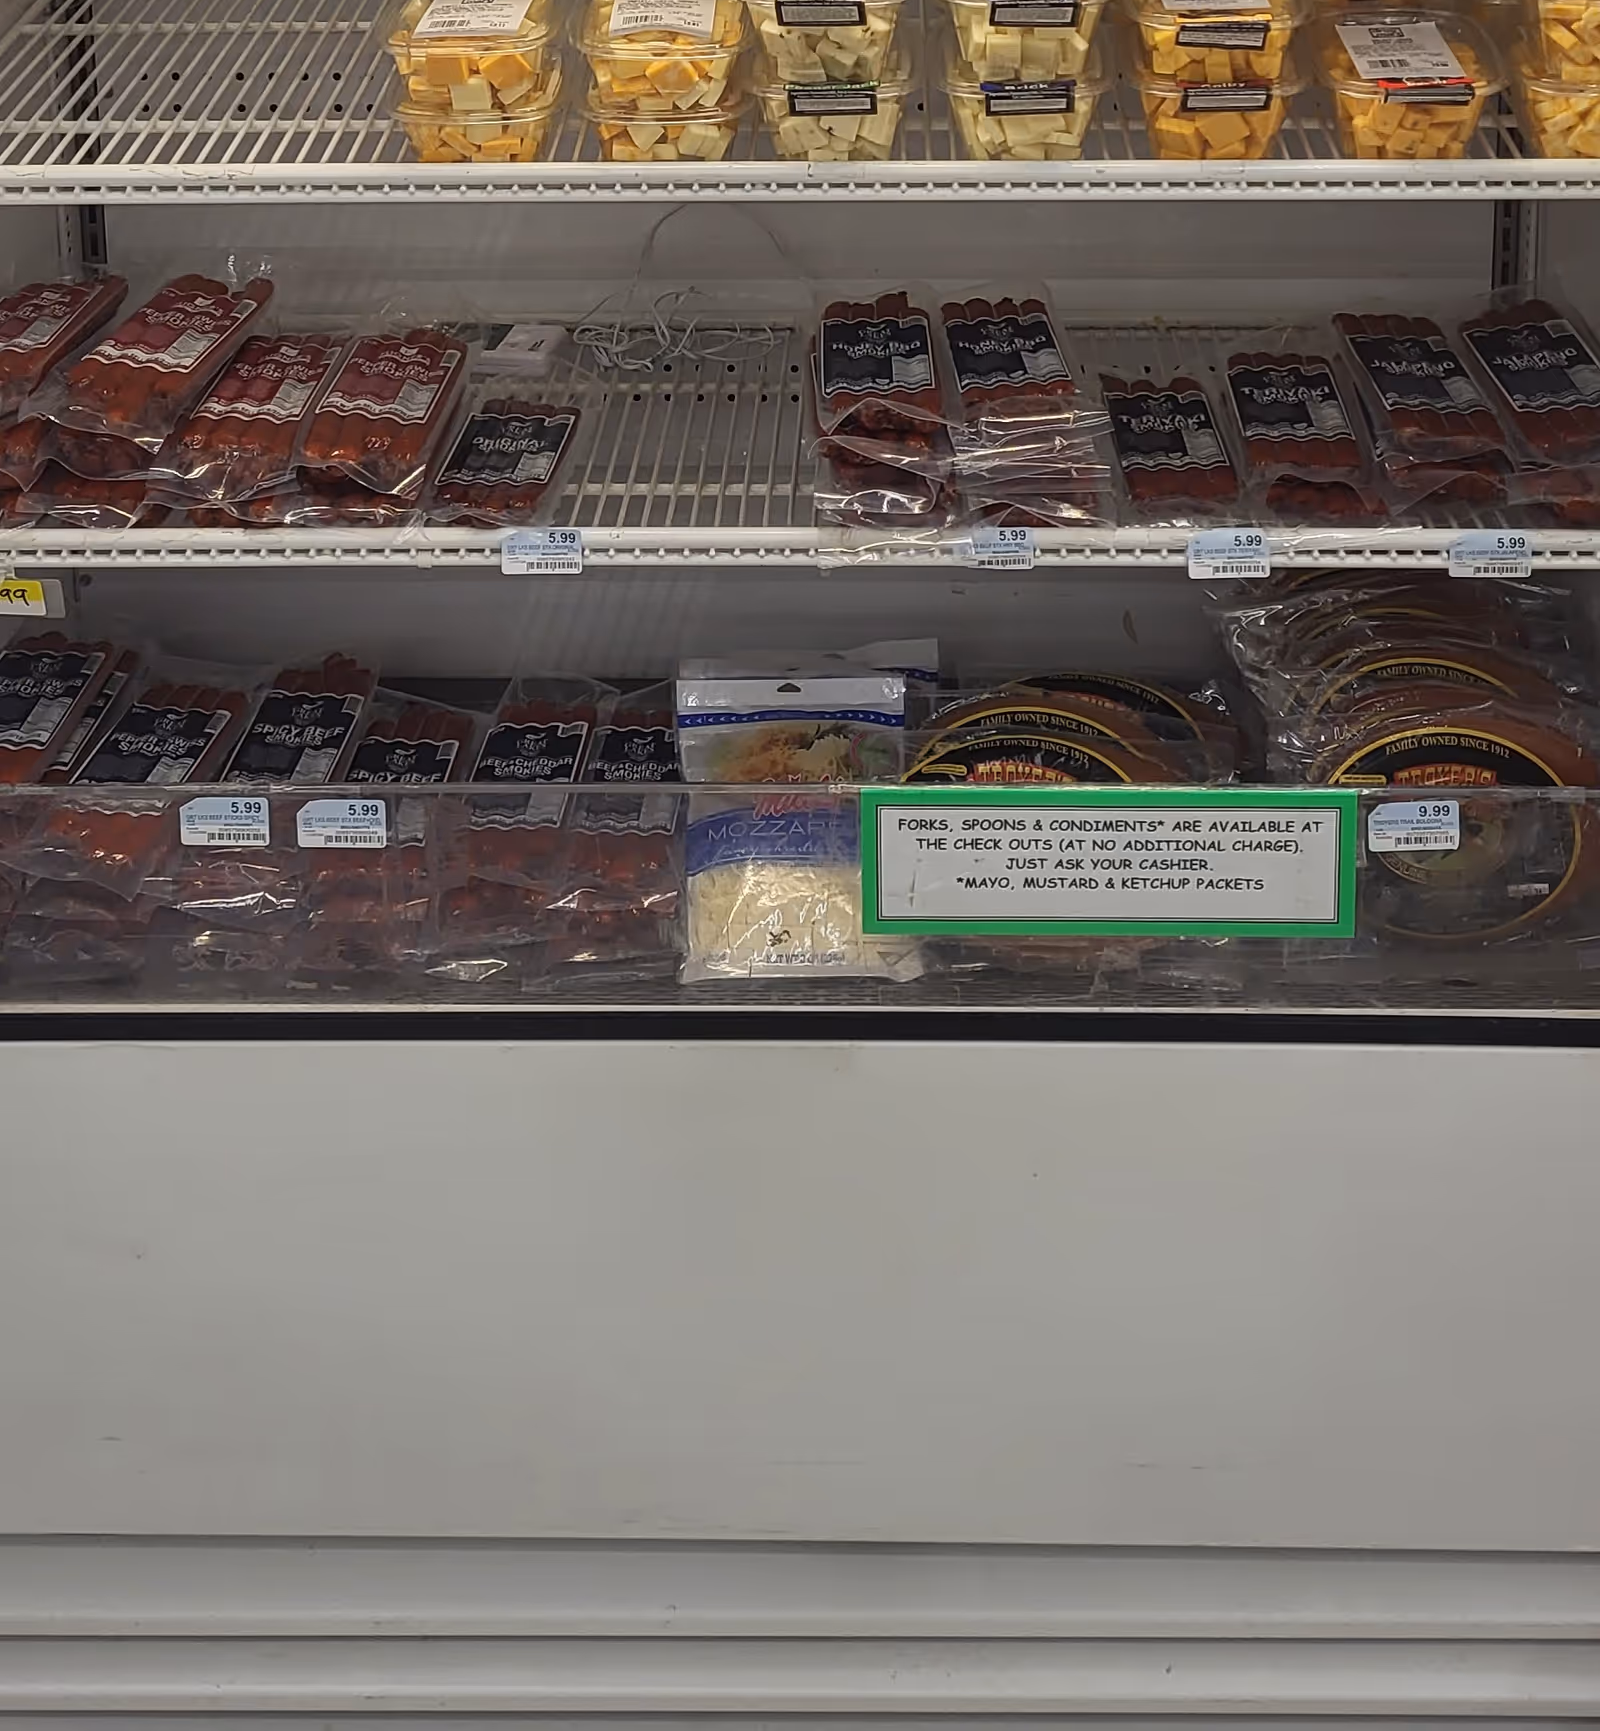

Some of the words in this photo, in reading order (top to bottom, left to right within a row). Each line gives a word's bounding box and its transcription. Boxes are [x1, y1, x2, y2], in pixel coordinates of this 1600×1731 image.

[548, 532, 576, 544] 5.99
[999, 530, 1026, 541] 5.99
[1234, 535, 1262, 546] 5.99
[1497, 537, 1525, 549] 5.99
[1411, 665, 1447, 677] OWNED
[252, 722, 300, 737] SPICY
[303, 725, 345, 739] BEEF
[981, 713, 1015, 728] FAMILY
[1014, 713, 1050, 724] OWNED
[1050, 716, 1078, 730] SINCE
[1080, 724, 1098, 737] 1912
[1003, 739, 1039, 748] OWNED
[1041, 741, 1069, 755] SINCE
[1070, 748, 1089, 764] 1912
[1386, 736, 1419, 756] FAMILY
[1421, 735, 1458, 746] OWNED
[1460, 737, 1489, 752] SINCE
[1491, 743, 1510, 759] 1912
[514, 756, 574, 768] CHEDDAR
[231, 801, 261, 814] 5.99
[348, 804, 378, 816] 5.99
[1418, 804, 1450, 817] 9.99
[898, 819, 953, 833] FORKS,
[961, 819, 1027, 832] SPOONS
[1033, 820, 1044, 832] &
[1172, 820, 1202, 833] ARE
[1208, 820, 1295, 834] AVAILABLE
[1301, 821, 1324, 834] AT
[916, 838, 948, 851] THE
[953, 838, 1003, 852] CHECK
[1008, 838, 1053, 852] OUTS
[1059, 838, 1086, 854] (AT
[1092, 839, 1117, 852] NO
[1123, 839, 1226, 853] ADDITIONAL
[1232, 839, 1304, 855] CHARGE).
[1005, 858, 1047, 871] JUST
[1054, 858, 1084, 871] ASK
[1090, 858, 1133, 871] YOUR
[1139, 858, 1214, 872] CASHIER.
[1022, 877, 1098, 891] MUSTARD
[1105, 878, 1115, 890] &
[1121, 878, 1190, 891] KETCHUP
[1197, 878, 1264, 891] PACKETS
